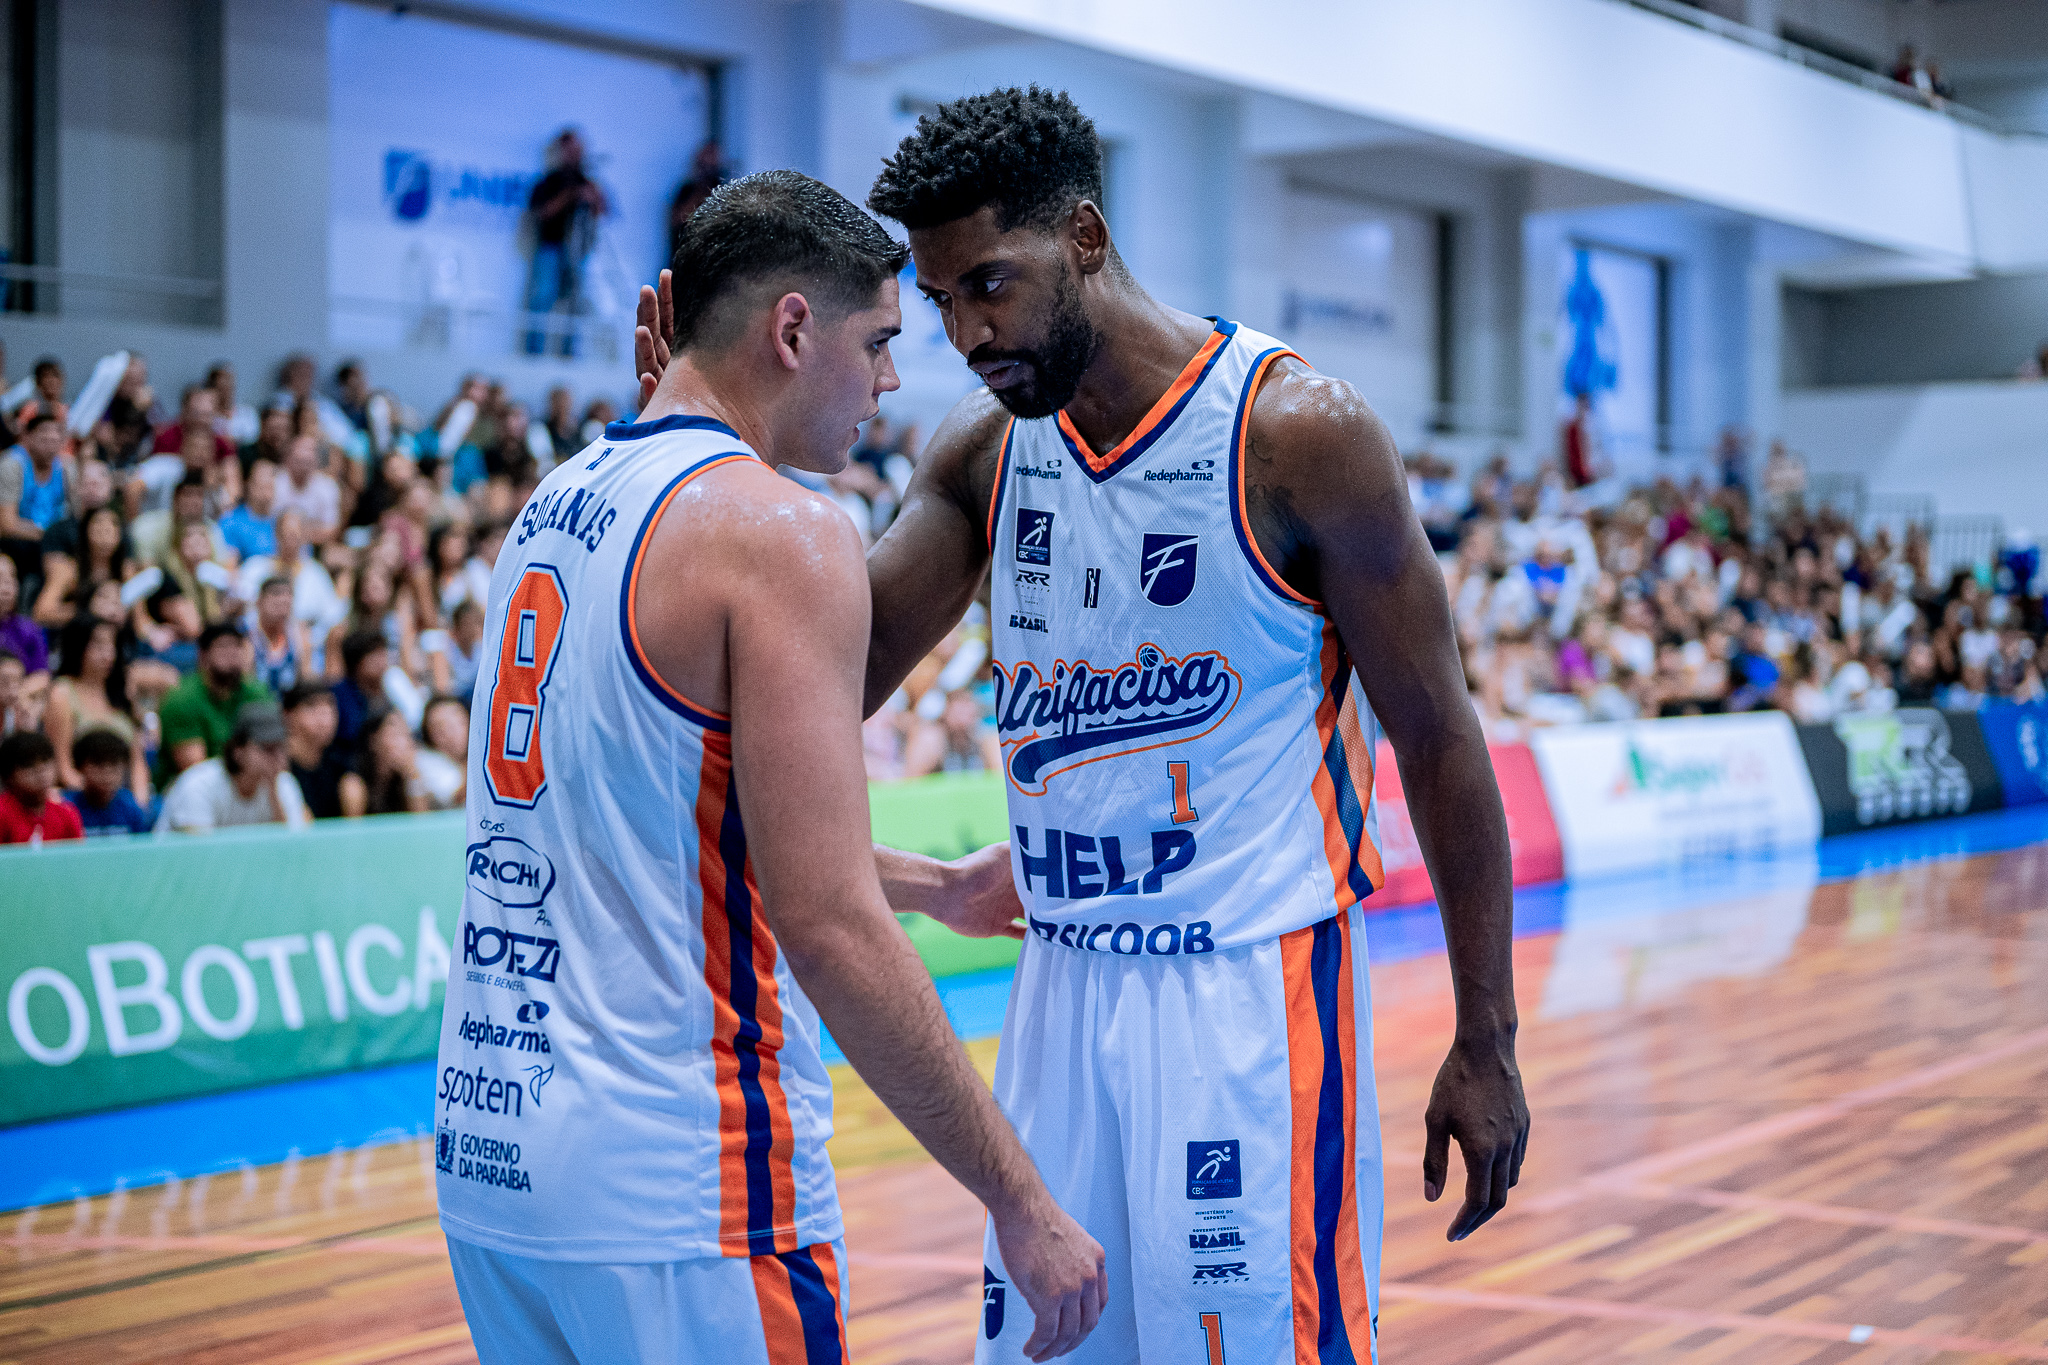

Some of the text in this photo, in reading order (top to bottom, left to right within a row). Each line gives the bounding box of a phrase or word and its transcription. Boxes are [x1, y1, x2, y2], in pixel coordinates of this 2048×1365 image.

[1144, 469, 1214, 484] Redepharma
[1009, 614, 1049, 633] BRASIL
[483, 562, 570, 810] 8
[993, 646, 1230, 737] Unifacisa
[1167, 760, 1199, 825] 1
[469, 850, 540, 889] RICHI
[1016, 824, 1197, 899] HELP
[460, 1133, 521, 1164] GOVERNO
[459, 1157, 532, 1193] DA PARAÍBA
[1191, 1187, 1205, 1195] CBC
[1189, 1232, 1245, 1248] BRASIL
[1199, 1311, 1226, 1365] 1
